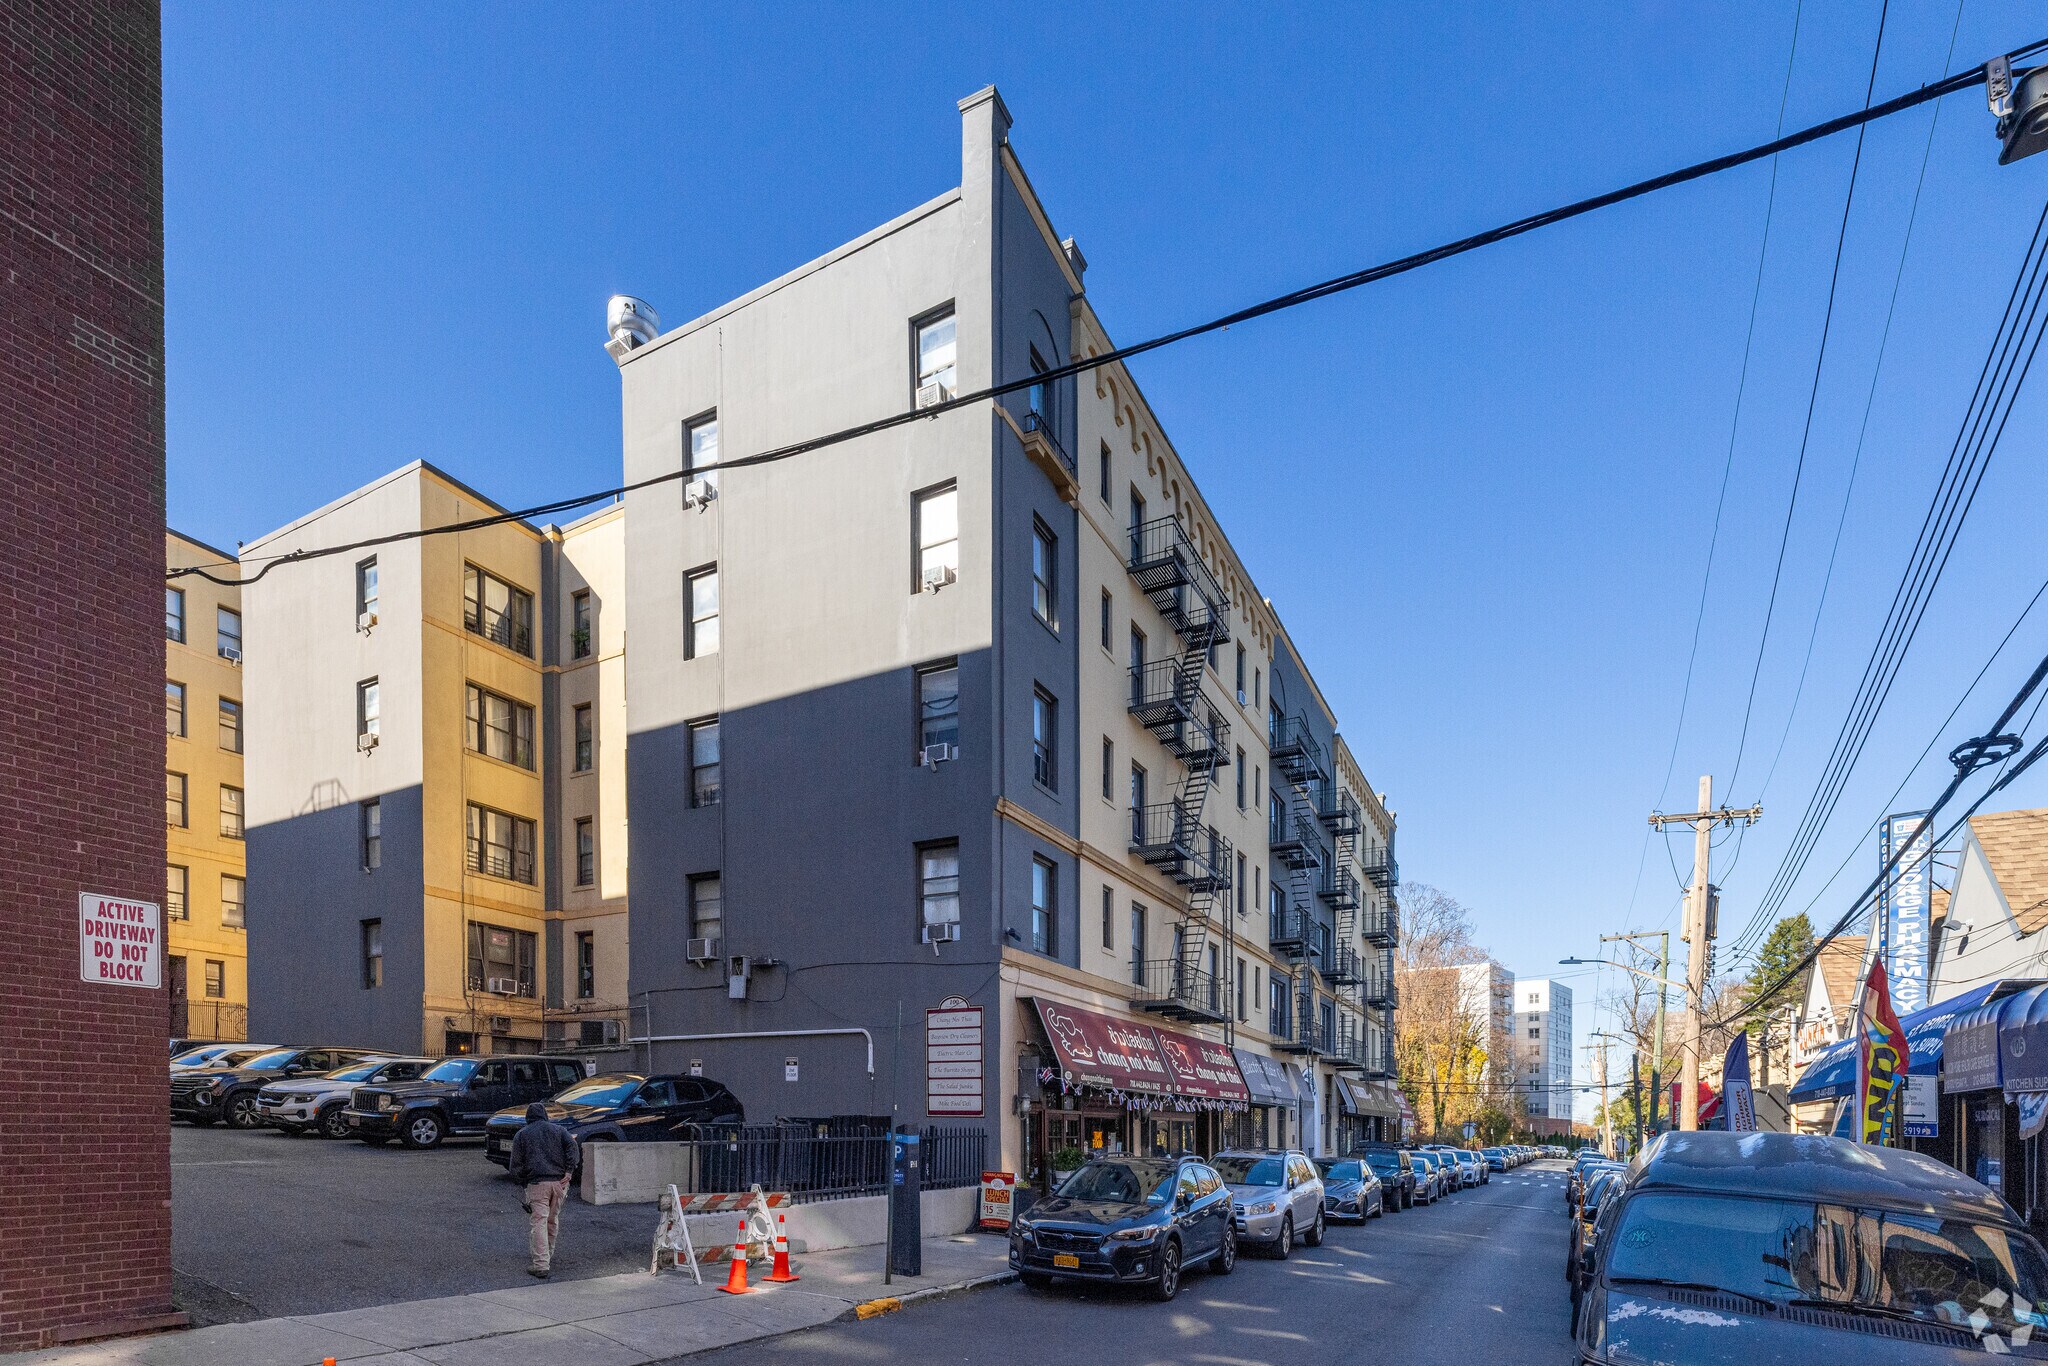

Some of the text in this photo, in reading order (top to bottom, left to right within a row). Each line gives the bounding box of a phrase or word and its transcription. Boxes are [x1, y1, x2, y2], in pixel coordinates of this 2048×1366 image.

[97, 900, 144, 923] ACTIVE
[84, 918, 156, 944] DRIVEWAY
[94, 940, 148, 963] DO NOT
[99, 960, 144, 982] BLOCK
[1893, 921, 1923, 1012] PHARMACY
[1096, 1046, 1165, 1074] chang noi thai
[2006, 1078, 2034, 1090] KITCHEN
[894, 1145, 902, 1159] P
[986, 1189, 1009, 1198] LUNCH
[986, 1195, 1008, 1204] SPECIAL
[983, 1205, 994, 1214] $15
